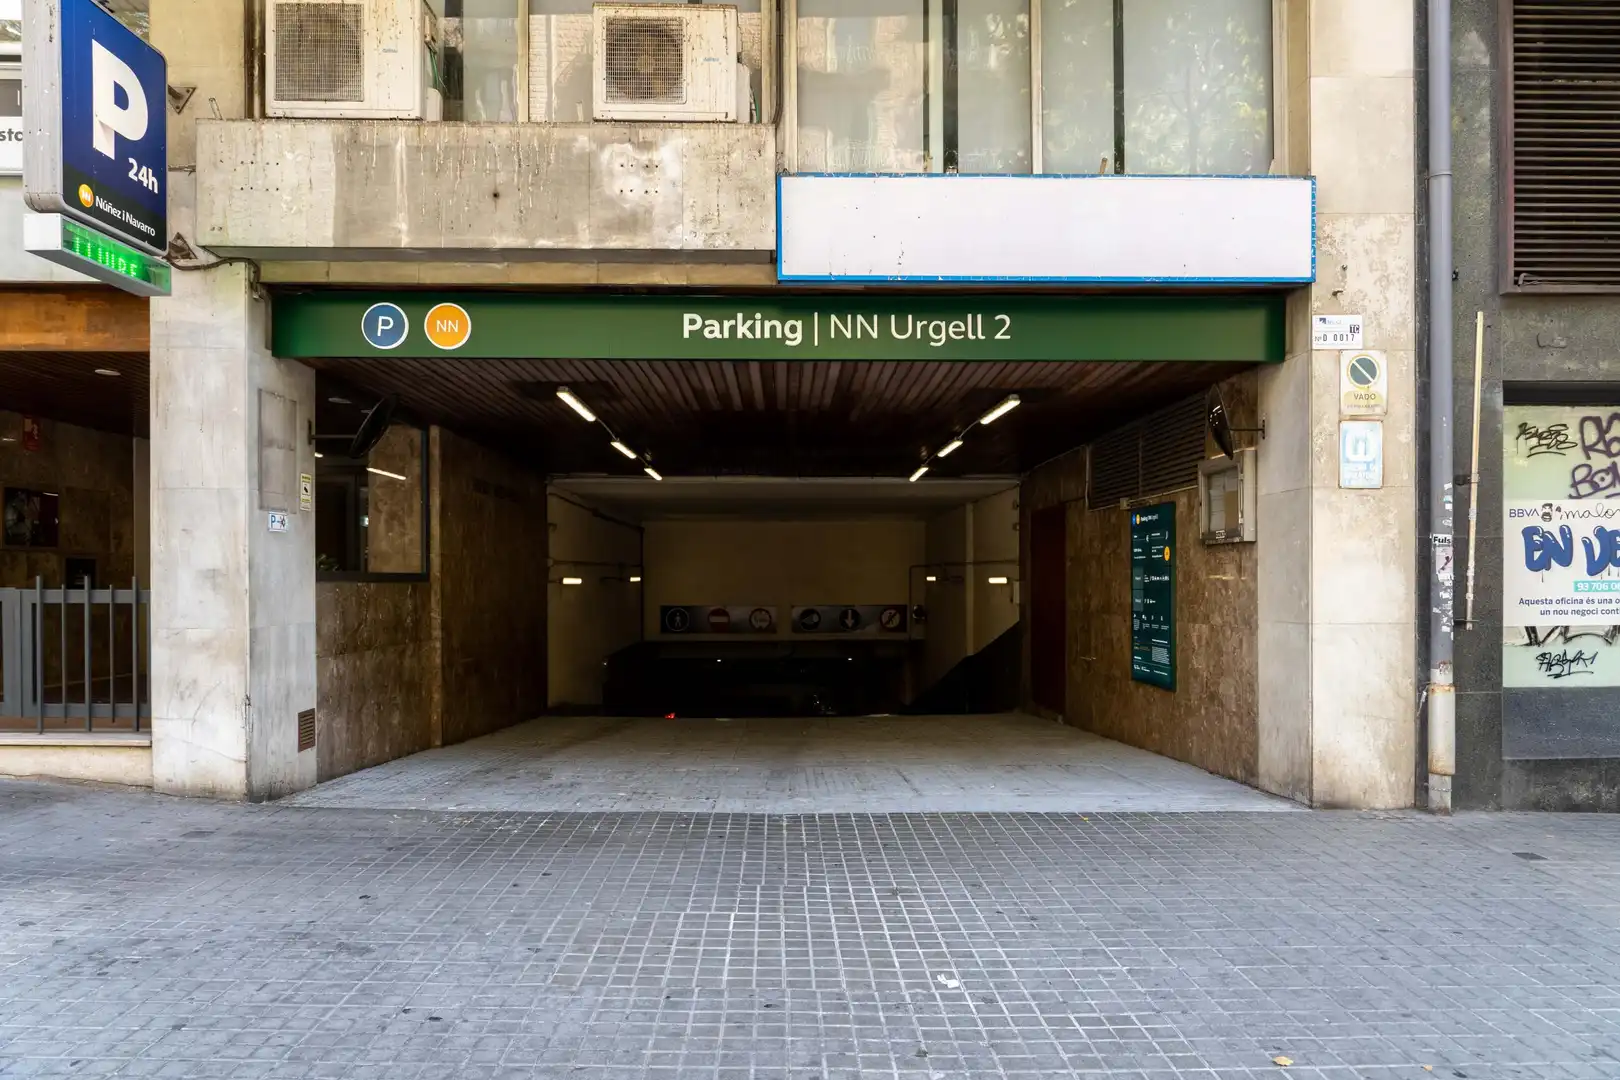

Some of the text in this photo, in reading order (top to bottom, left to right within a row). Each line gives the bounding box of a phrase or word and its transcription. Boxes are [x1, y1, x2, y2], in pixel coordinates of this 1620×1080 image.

[92, 38, 148, 160] P
[128, 157, 158, 194] 24h
[95, 195, 156, 236] Núñez i Navarro
[377, 316, 394, 337] P
[436, 319, 459, 333] NN
[683, 312, 802, 346] Parking
[830, 314, 878, 339] NN
[891, 313, 985, 347] Urgell
[994, 314, 1011, 340] 2
[1333, 333, 1355, 341] 0017
[1353, 393, 1377, 401] VADO
[1509, 508, 1540, 518] BBVA
[1521, 524, 1574, 572] EN
[1577, 582, 1589, 591] 93
[1591, 582, 1609, 591] 706
[1518, 597, 1553, 607] Aquesta
[1555, 596, 1583, 605] oficina
[1585, 596, 1595, 605] és
[1571, 607, 1598, 617] negoci
